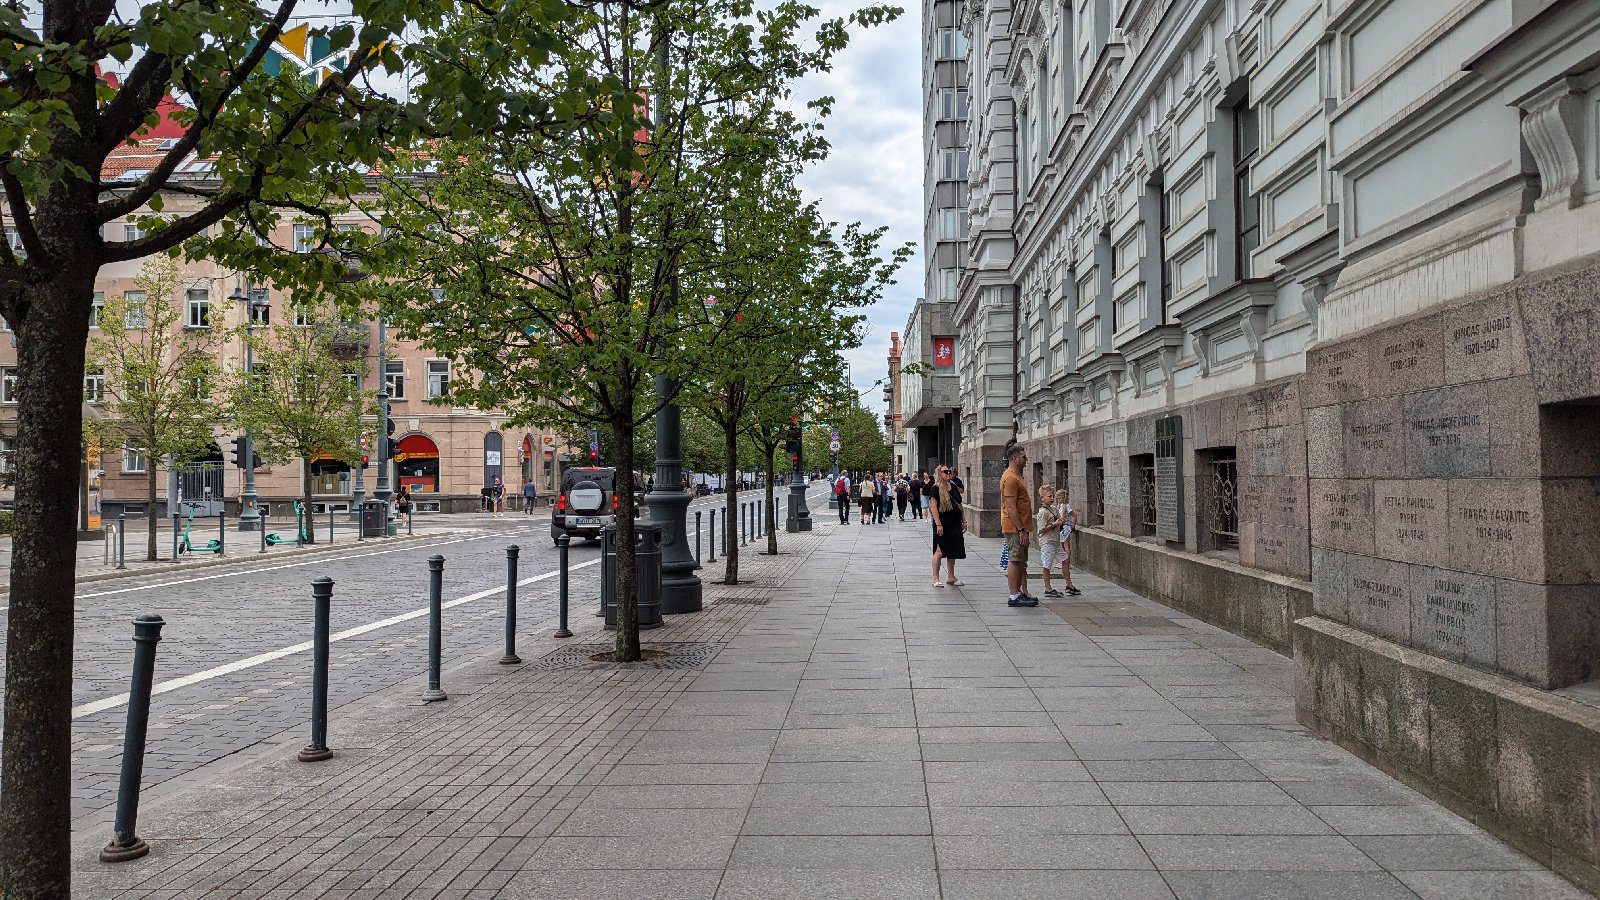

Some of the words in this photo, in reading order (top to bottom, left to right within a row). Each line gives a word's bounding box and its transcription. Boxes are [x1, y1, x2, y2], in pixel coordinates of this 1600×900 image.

[1453, 324, 1480, 342] VINCAS
[1481, 316, 1511, 334] JUODIS
[1464, 338, 1500, 357] 1920-1947
[1410, 418, 1435, 432] VINCAS
[1384, 496, 1405, 508] PETRAS
[1458, 507, 1488, 521] PRANAS
[1490, 508, 1530, 524] KALVAITIS
[1476, 526, 1512, 541] 1914-1945
[1434, 579, 1465, 596] ANTANAS
